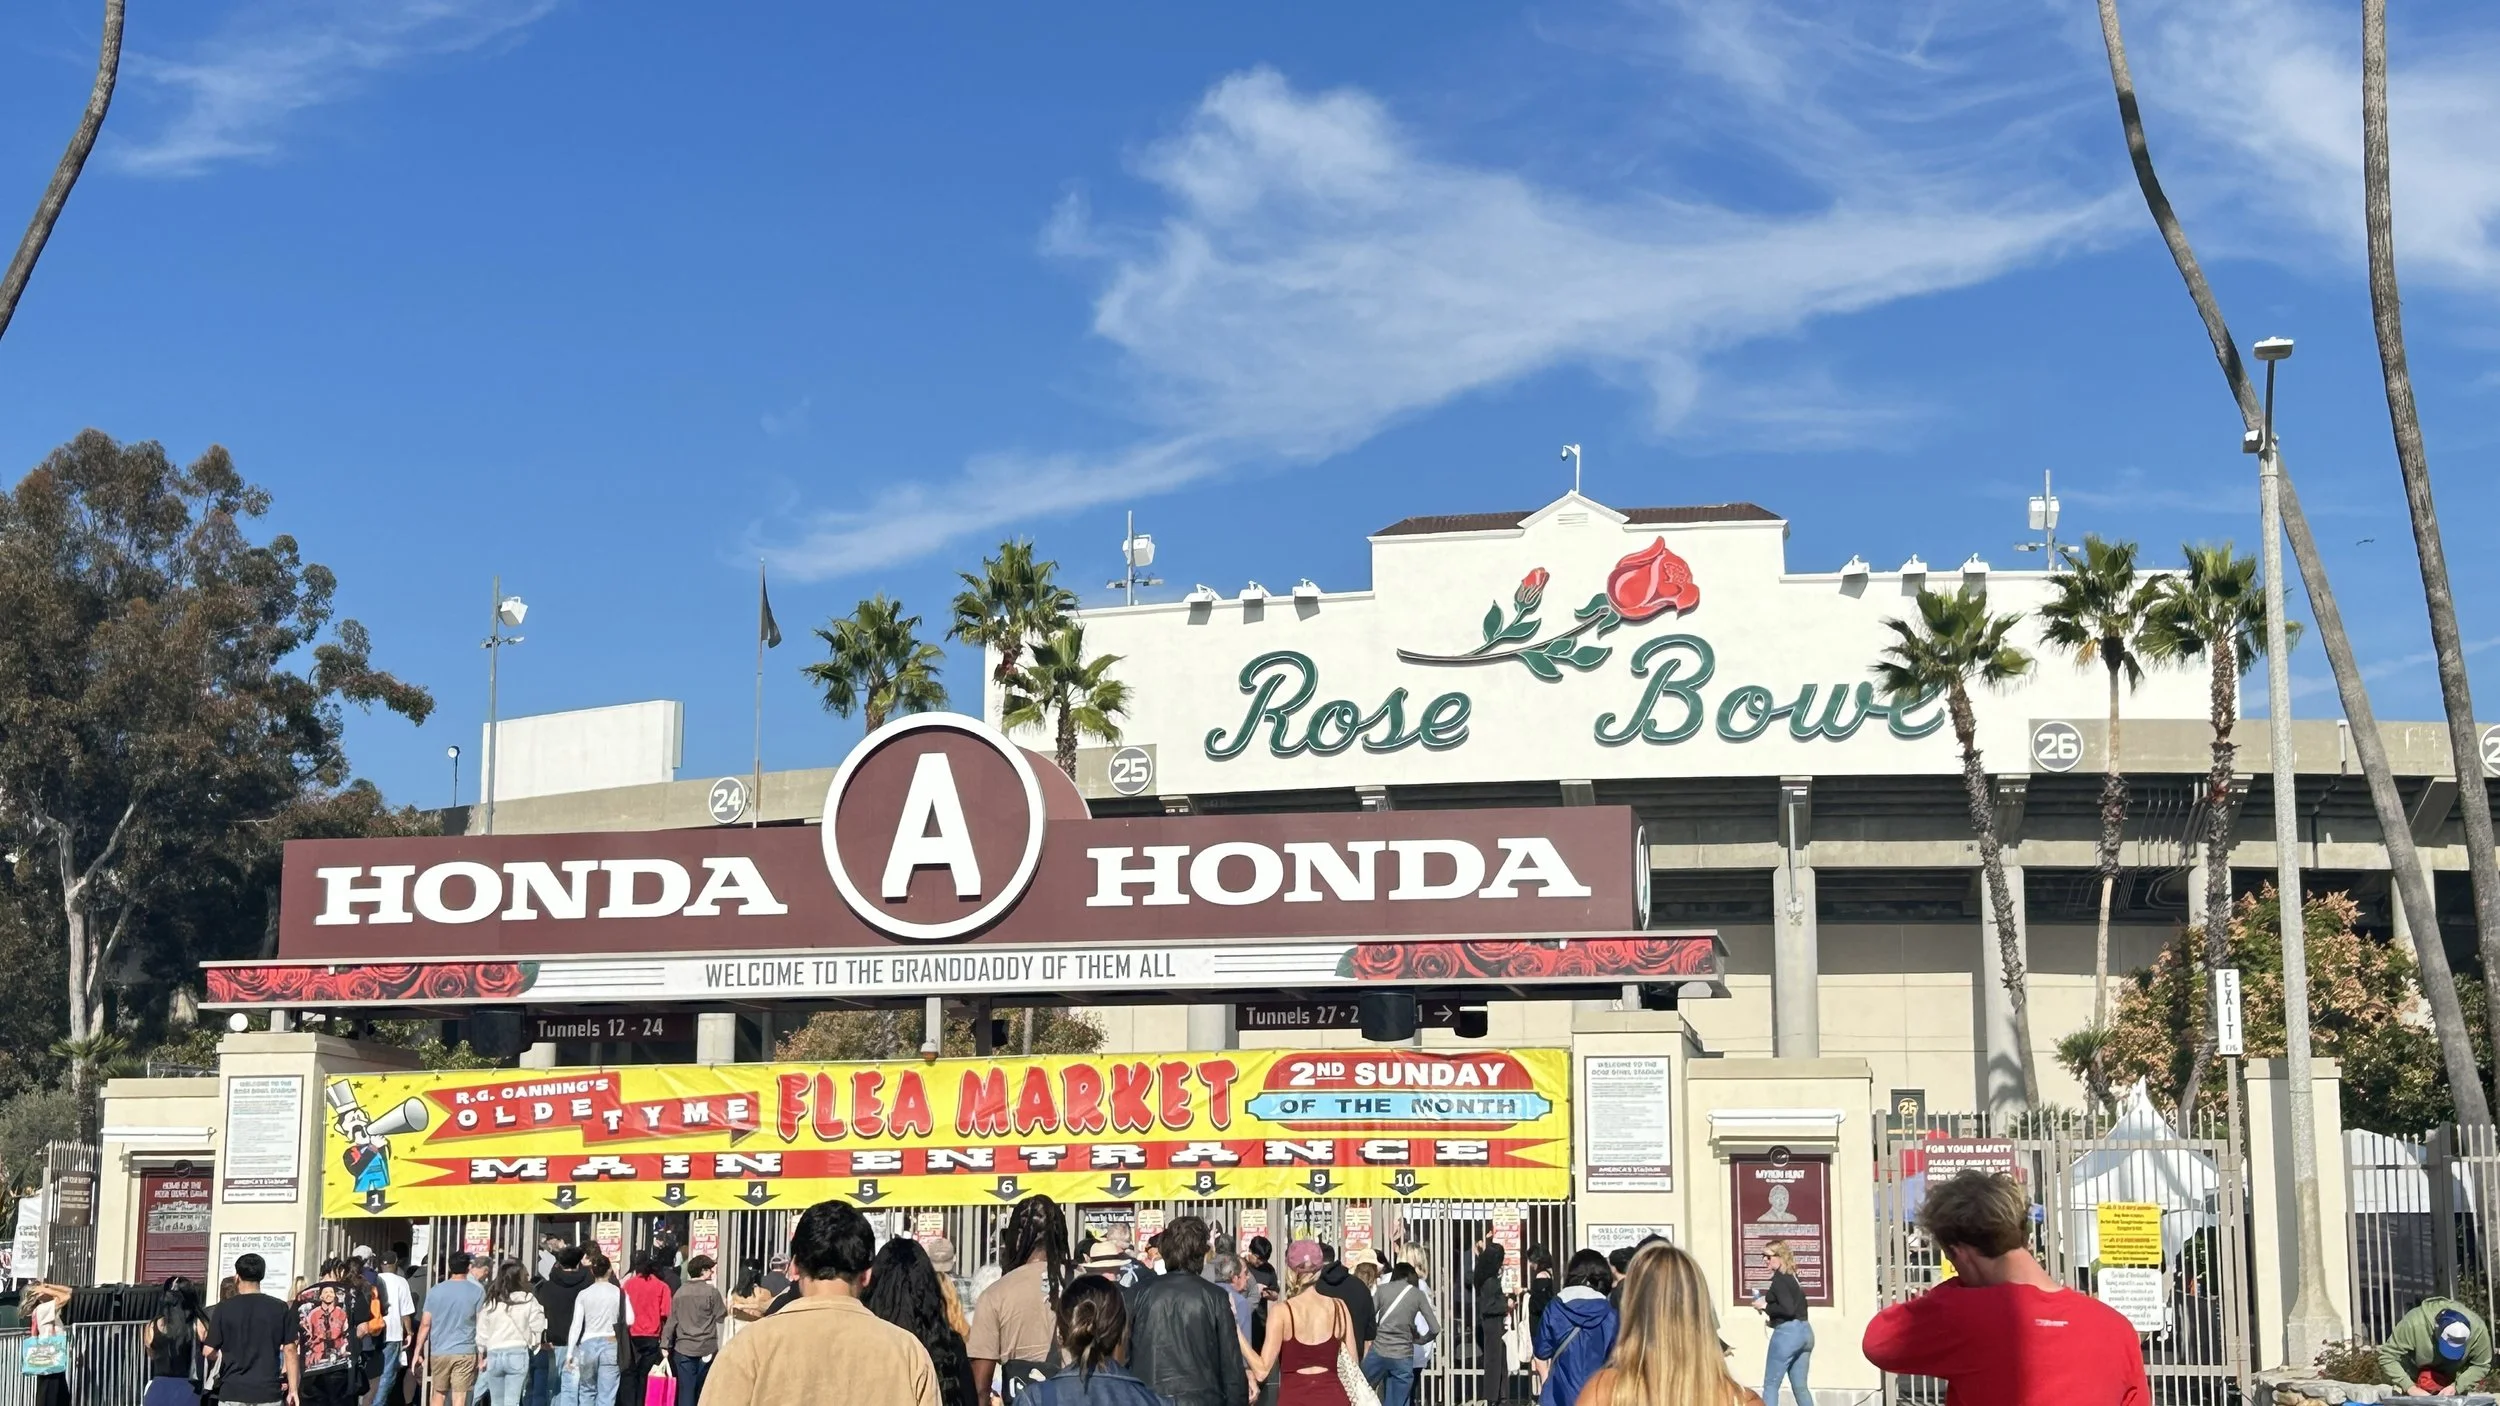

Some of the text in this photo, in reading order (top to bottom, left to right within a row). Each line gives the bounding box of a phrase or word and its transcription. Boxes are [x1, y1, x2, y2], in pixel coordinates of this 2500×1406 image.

[1204, 650, 1473, 762] Rose
[2037, 732, 2079, 760] 26
[2485, 736, 2500, 764] 2
[1113, 757, 1149, 784] 25
[713, 787, 742, 813] 24
[882, 752, 982, 899] A
[1086, 837, 1592, 907] HONDA
[315, 856, 789, 926] HONDA
[705, 952, 1177, 988] WELCOME TO THE GRANDDADDY OF THEM ALL
[1246, 1005, 1310, 1025] Tunnels
[1316, 1005, 1338, 1024] 27
[1350, 1005, 1359, 1024] 2
[2224, 972, 2234, 1040] EXIT
[537, 1019, 600, 1038] Tunnels
[608, 1019, 625, 1037] 12
[642, 1018, 664, 1036] 24
[1290, 1062, 1505, 1086] 2ND SUNDAY
[456, 1078, 609, 1104] R.G. CANNING'S
[776, 1059, 1239, 1143] FLEA MARKET
[457, 1098, 750, 1134] OLDE TYME
[1280, 1098, 1517, 1114] OF THE MONTH
[469, 1138, 1491, 1183] MAIN ENTRANCE
[1946, 1144, 1974, 1154] YOUR
[751, 1184, 763, 1198] 4
[863, 1184, 873, 1196] 5
[1002, 1180, 1013, 1193] 6
[1115, 1178, 1126, 1190] 7
[1200, 1176, 1212, 1190] 8
[1314, 1174, 1326, 1187] 9
[1396, 1174, 1415, 1187] 10
[371, 1193, 381, 1207] 1
[562, 1188, 573, 1201] 2
[670, 1186, 681, 1200] 3
